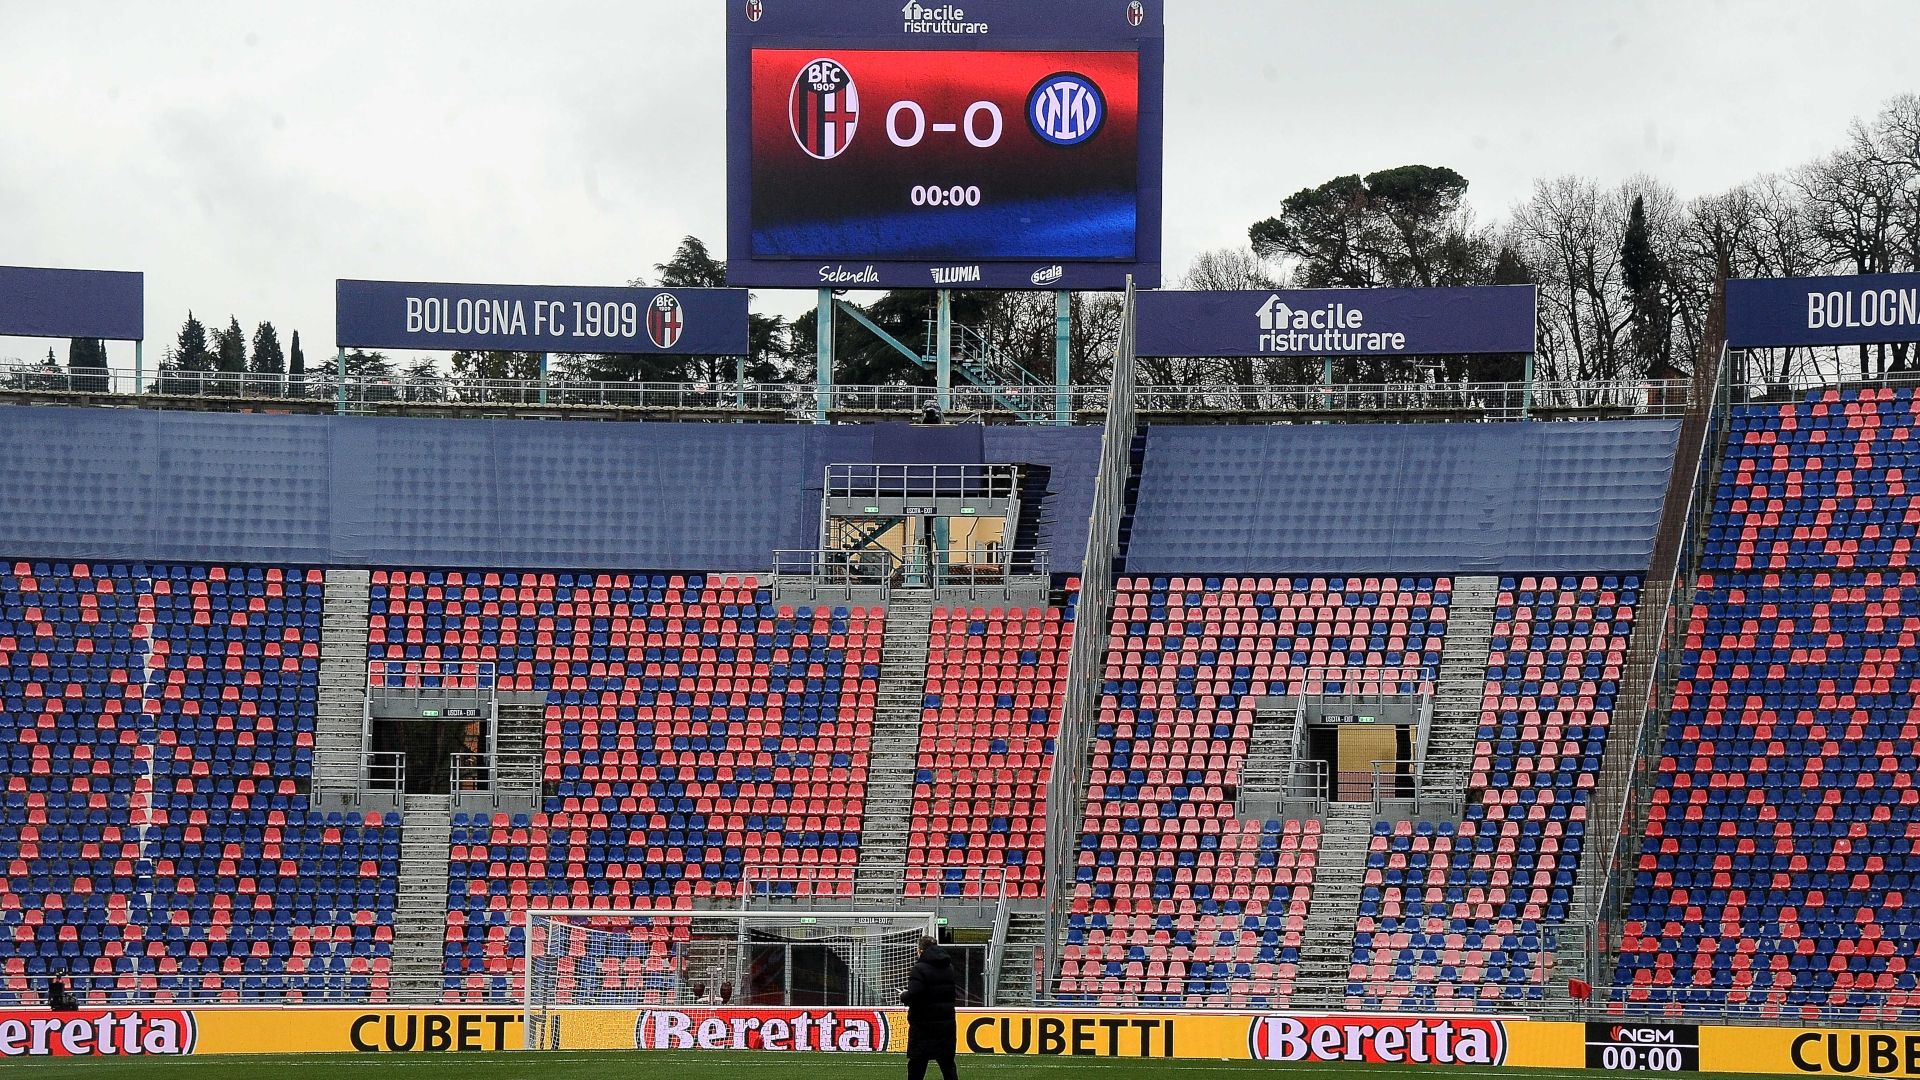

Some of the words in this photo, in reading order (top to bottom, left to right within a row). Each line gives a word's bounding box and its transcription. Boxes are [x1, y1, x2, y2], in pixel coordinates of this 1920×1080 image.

[905, 1, 964, 20] facile
[904, 20, 989, 34] ristrutturare
[808, 63, 841, 83] BFC
[813, 83, 835, 91] 1909
[911, 185, 981, 207] 00:00
[818, 265, 880, 283] Selenella
[931, 265, 981, 284] ILLUMIA
[1033, 265, 1063, 282] scala
[656, 294, 674, 307] BFC
[1808, 288, 1920, 329] BOLOGN
[406, 297, 527, 336] BOLOGNA
[534, 300, 566, 337] FC
[572, 301, 637, 338] 1909
[1257, 296, 1363, 330] facile
[1259, 328, 1406, 352] ristrutturare
[654, 1010, 872, 1052] Beretta
[965, 1017, 1174, 1057] CUBETTI
[1264, 1017, 1491, 1064] Beretta
[1618, 1024, 1675, 1043] NGM
[1602, 1046, 1682, 1072] 00:00
